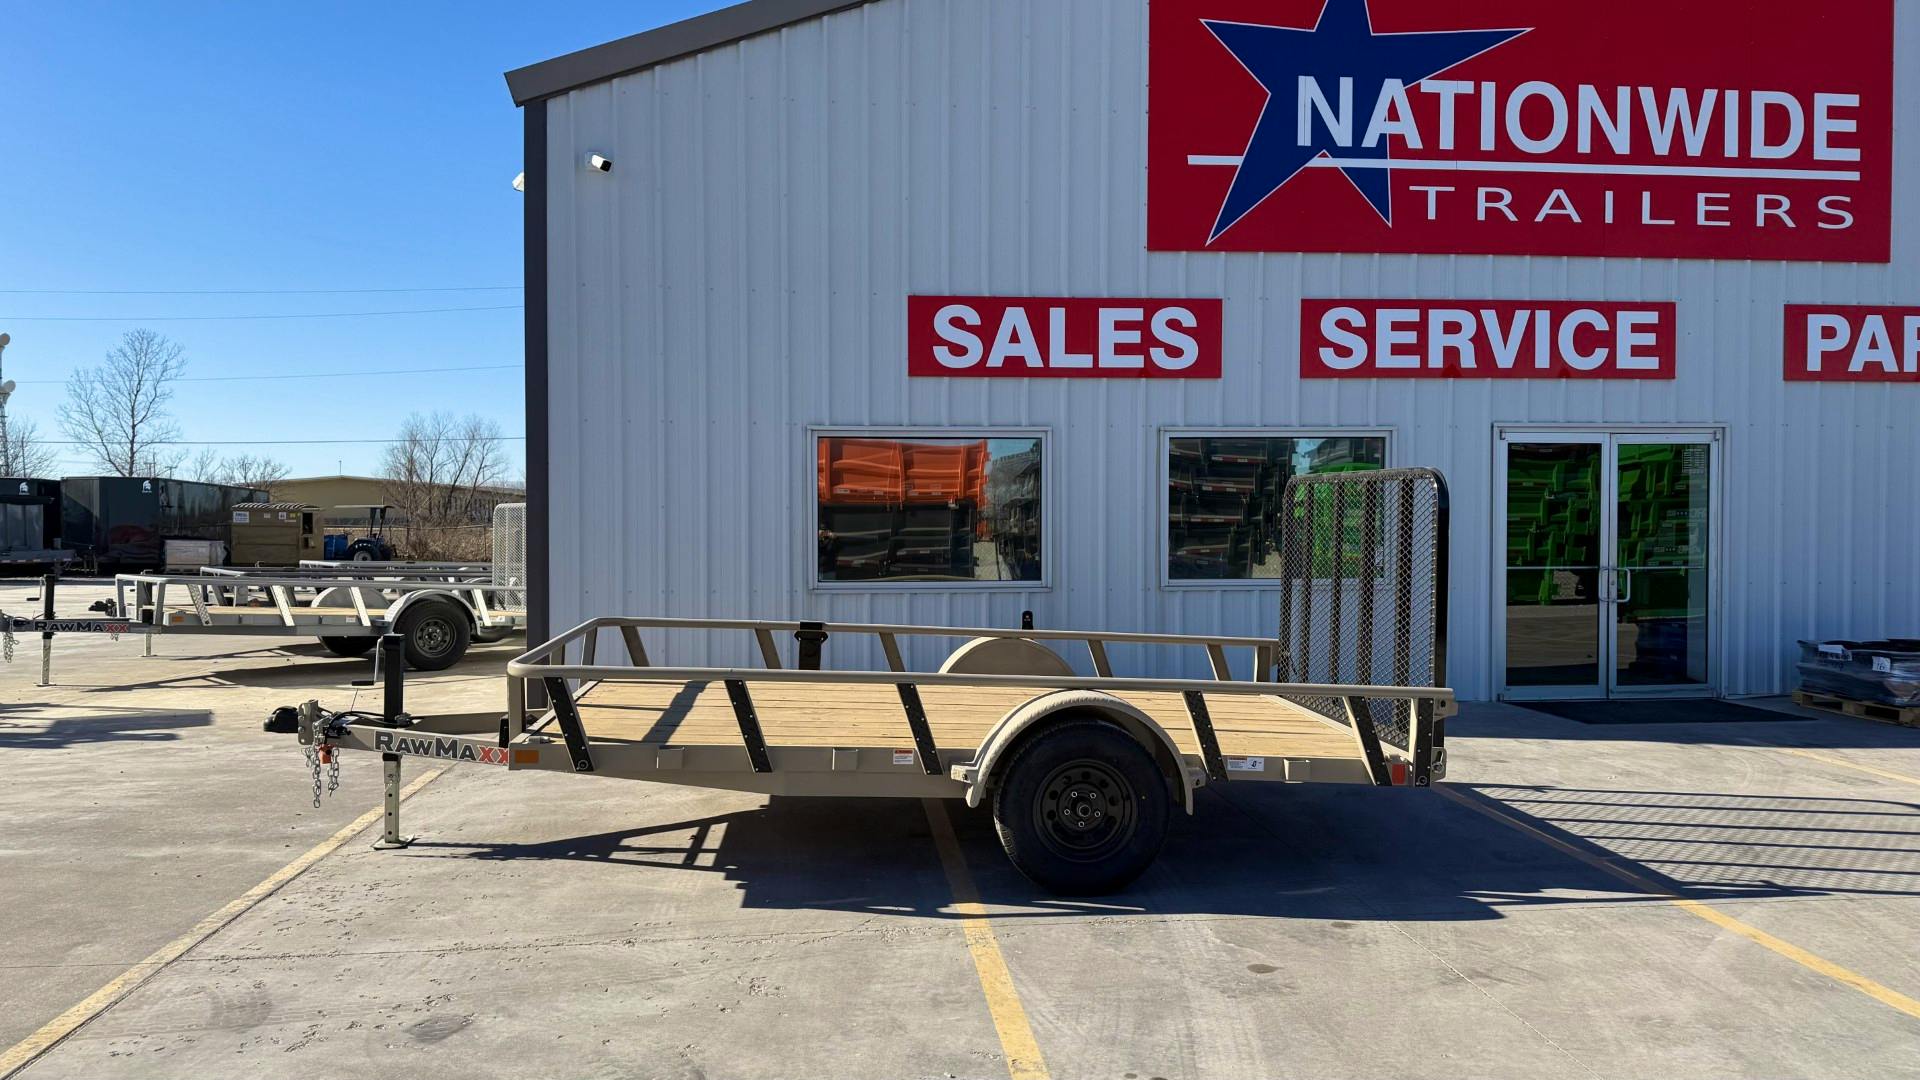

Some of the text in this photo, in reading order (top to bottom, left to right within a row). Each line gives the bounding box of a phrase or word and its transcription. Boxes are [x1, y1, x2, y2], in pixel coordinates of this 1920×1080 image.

[1296, 75, 1861, 163] NATIONWIDE
[1409, 186, 1855, 230] TRAILERS
[932, 304, 1199, 370] SALES
[1318, 307, 1660, 370] SERVICE
